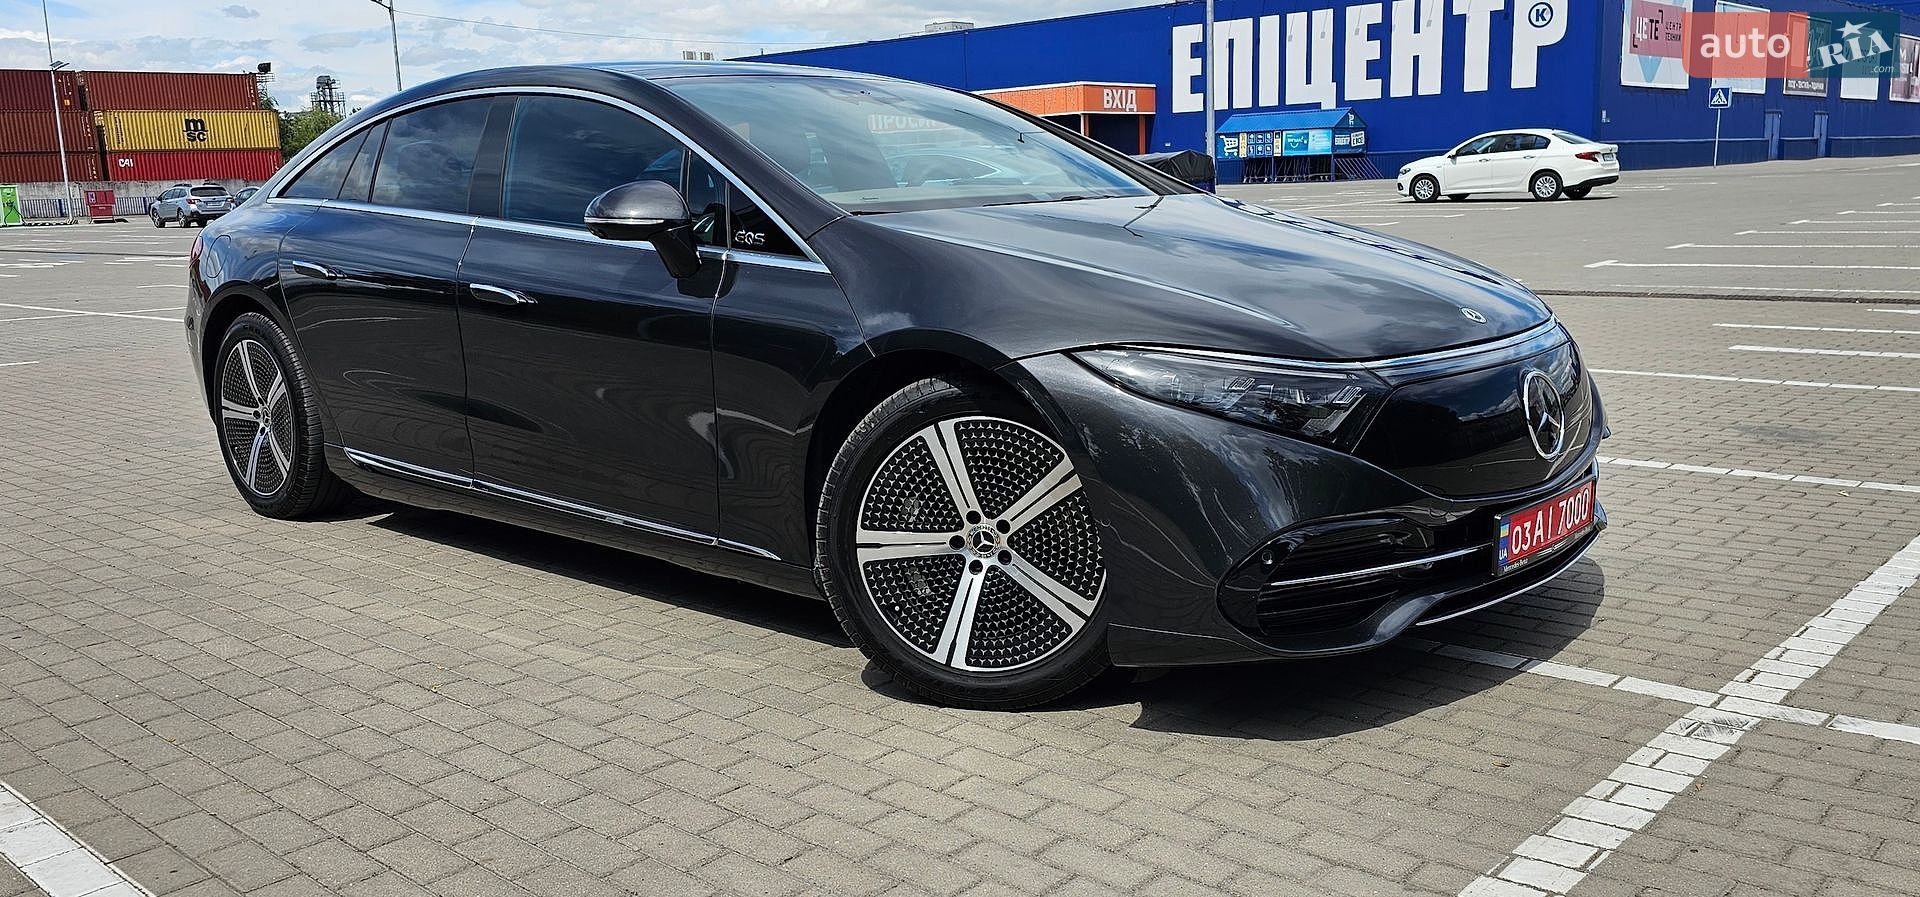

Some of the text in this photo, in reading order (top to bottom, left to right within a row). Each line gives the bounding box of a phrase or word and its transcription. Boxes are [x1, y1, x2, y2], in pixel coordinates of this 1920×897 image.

[1636, 16, 1660, 41] ЦЕТЕ
[1172, 0, 1568, 113] ЕПІЦЕНТР
[1104, 88, 1137, 112] ВХІД
[118, 158, 134, 168] CAI
[735, 230, 765, 246] EQS
[1499, 548, 1508, 560] UA
